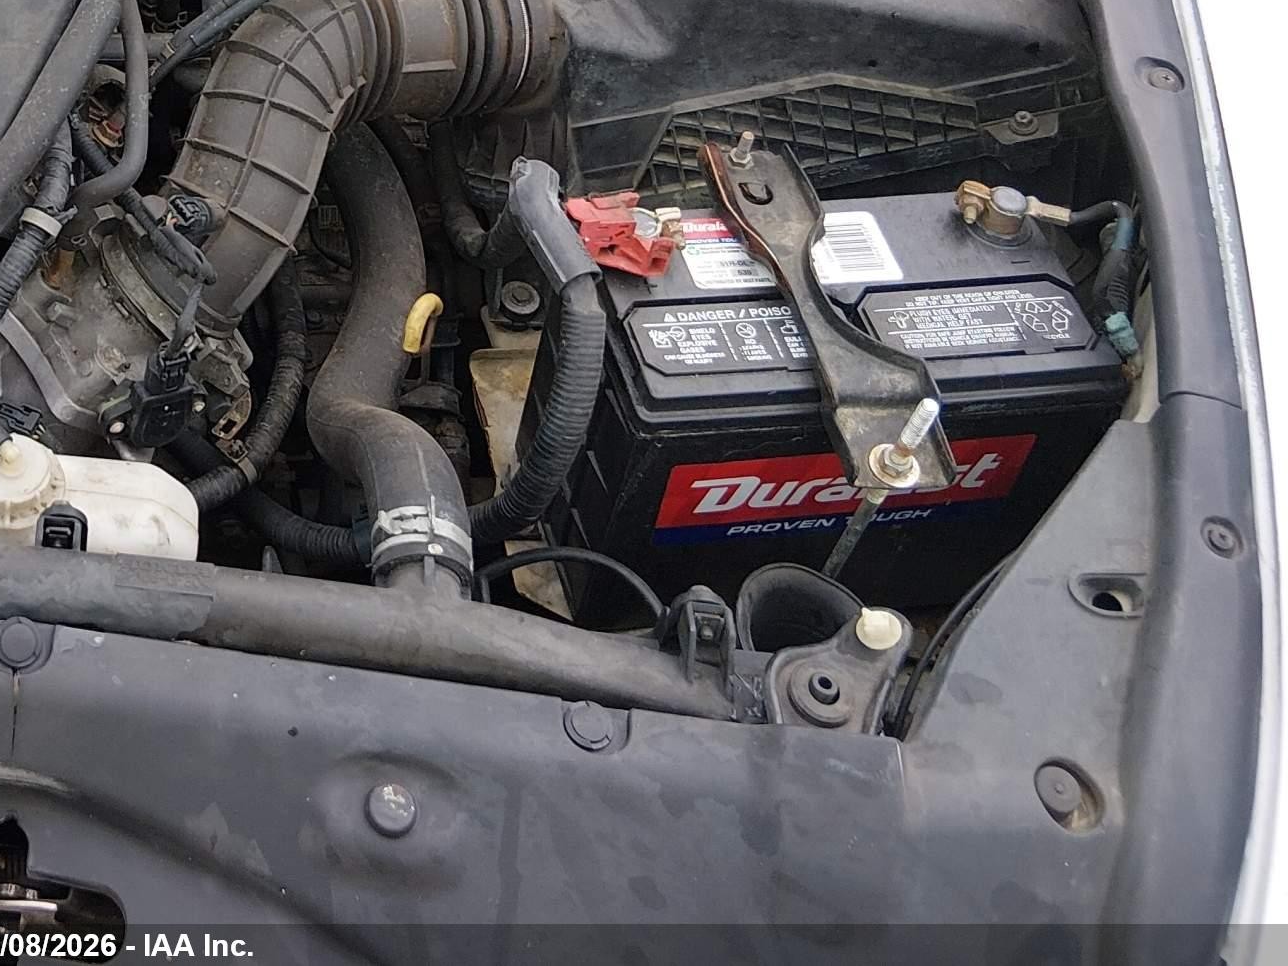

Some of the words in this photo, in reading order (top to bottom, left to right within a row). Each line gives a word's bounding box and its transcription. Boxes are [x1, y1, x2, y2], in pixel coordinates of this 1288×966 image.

[677, 309, 735, 322] DANGER
[750, 306, 793, 318] POISO
[951, 305, 996, 314] IMMEDIATELY
[691, 333, 712, 341] EYES
[680, 346, 706, 354] GASES
[691, 453, 1001, 514] Durat
[727, 517, 836, 536] PROVEN
